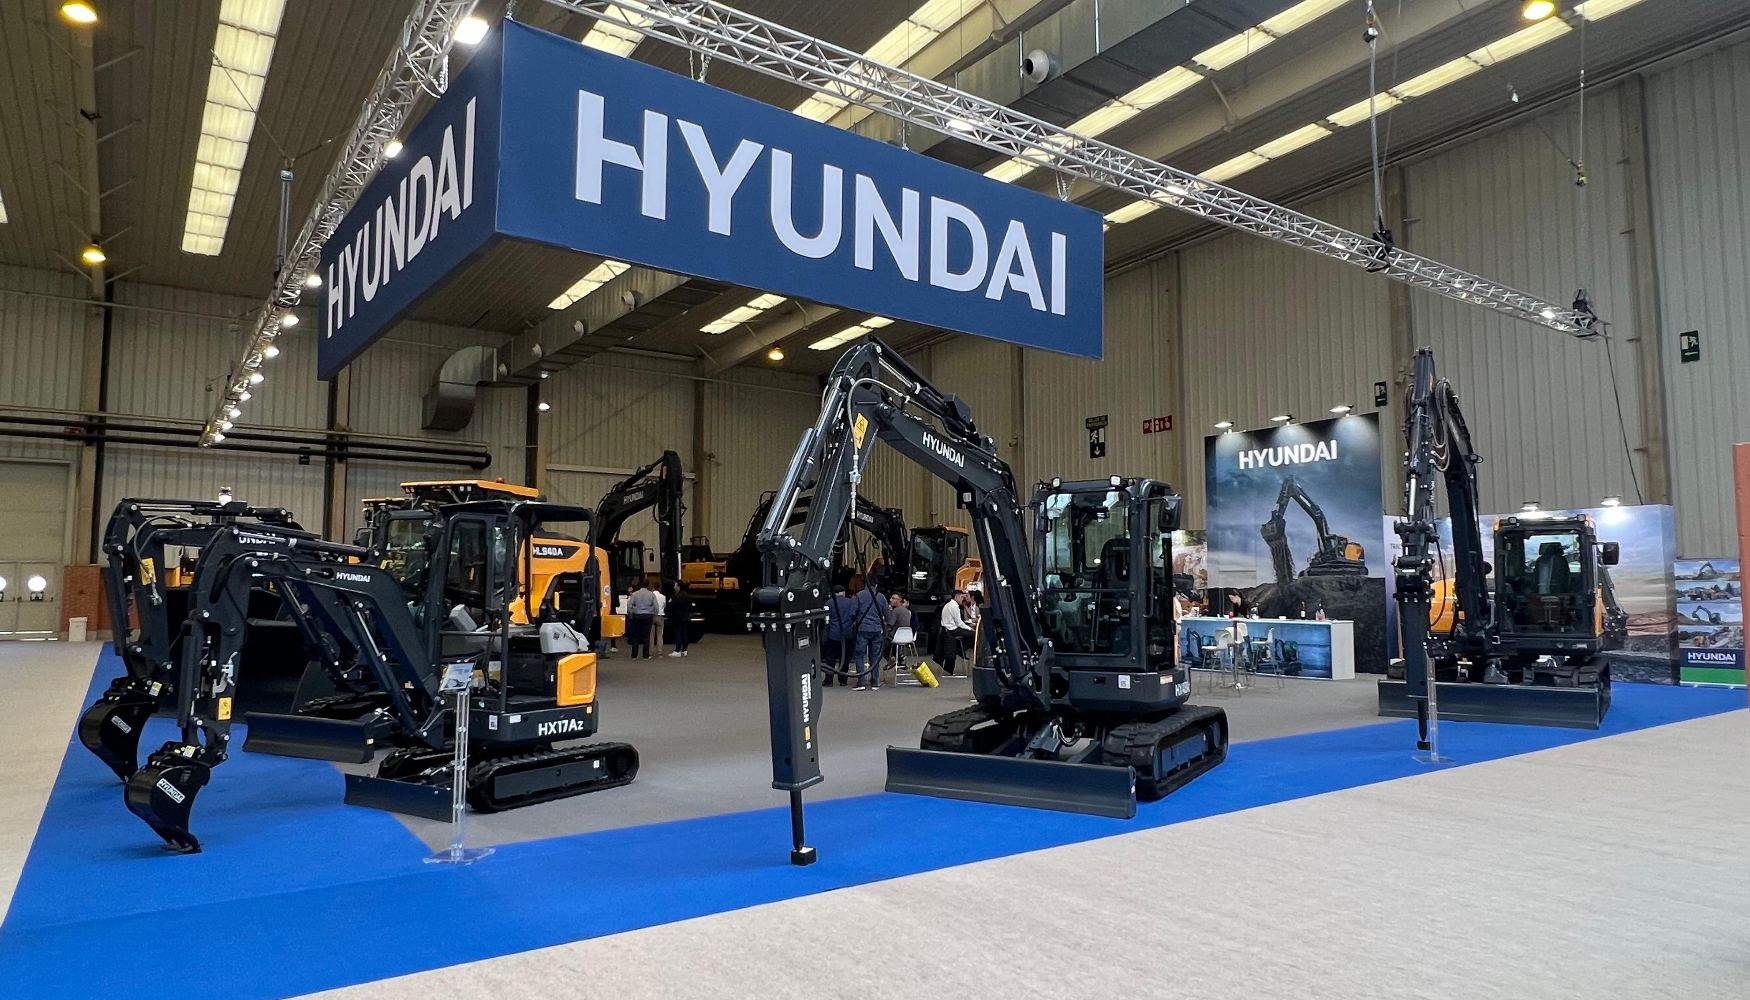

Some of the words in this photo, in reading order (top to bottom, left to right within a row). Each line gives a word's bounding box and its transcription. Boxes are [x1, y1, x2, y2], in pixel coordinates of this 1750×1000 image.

[327, 96, 476, 338] HYUNDAI
[575, 89, 1067, 316] HYUNDAI
[922, 431, 965, 468] HYUNDAI
[1238, 439, 1338, 470] HYUNDAI
[533, 546, 563, 556] HL940A
[336, 571, 371, 583] HYUNDAI
[1687, 652, 1736, 662] HYUNDAI
[801, 673, 809, 722] HYUNDAI
